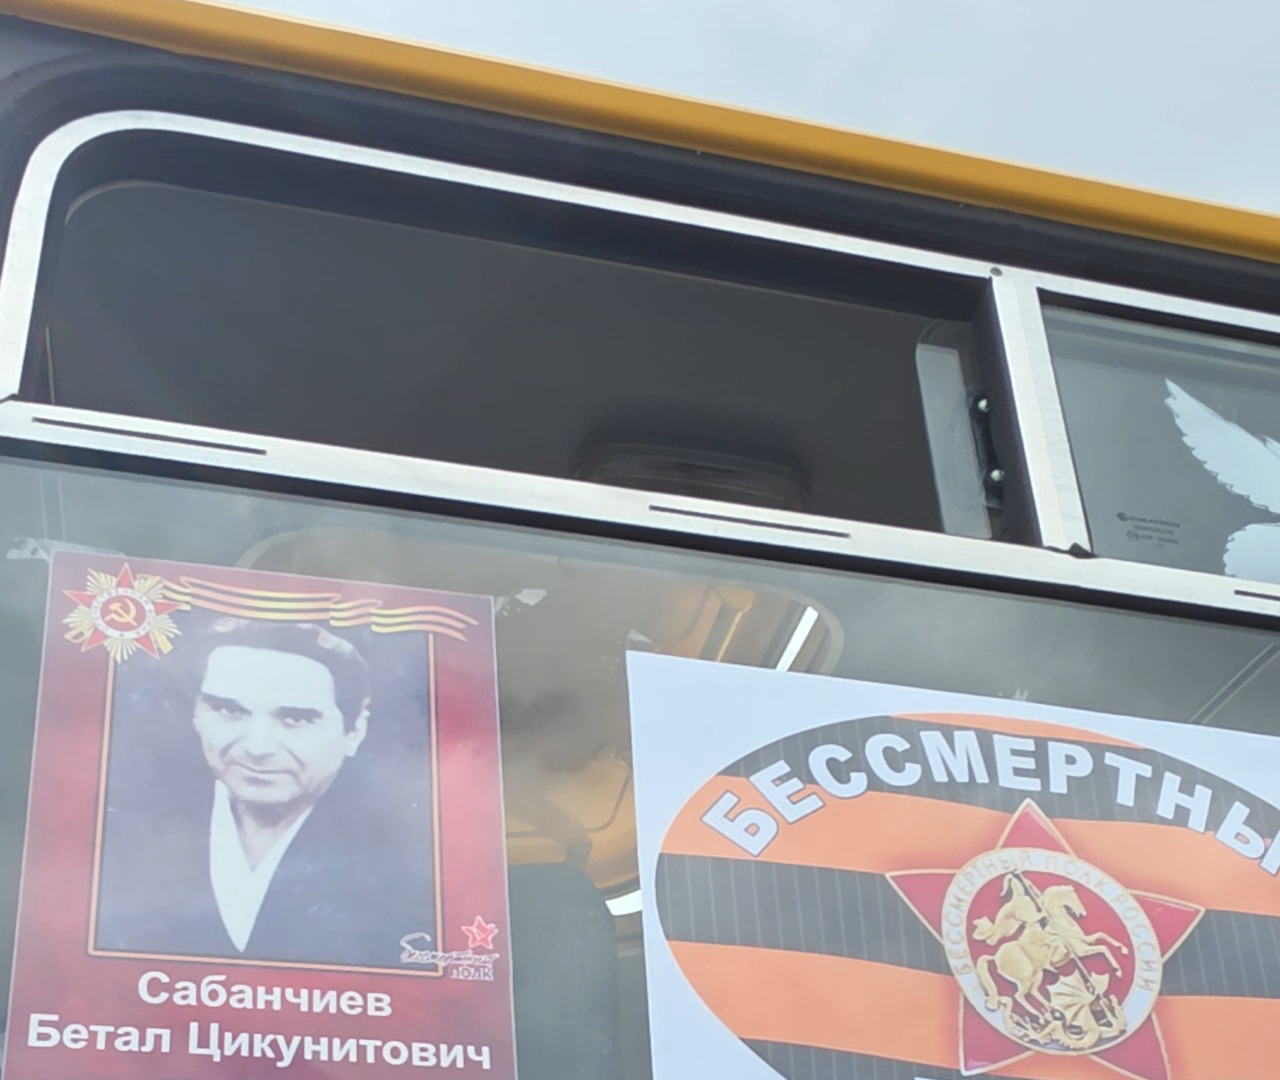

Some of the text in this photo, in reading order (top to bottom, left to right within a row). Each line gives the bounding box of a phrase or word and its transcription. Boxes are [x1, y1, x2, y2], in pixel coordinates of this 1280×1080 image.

[1044, 855, 1107, 894] ПОЛК
[1112, 892, 1158, 992] РОССИИ
[138, 970, 392, 1017] Сабанчиев
[27, 1013, 491, 1070] Бетал Цикунитович
